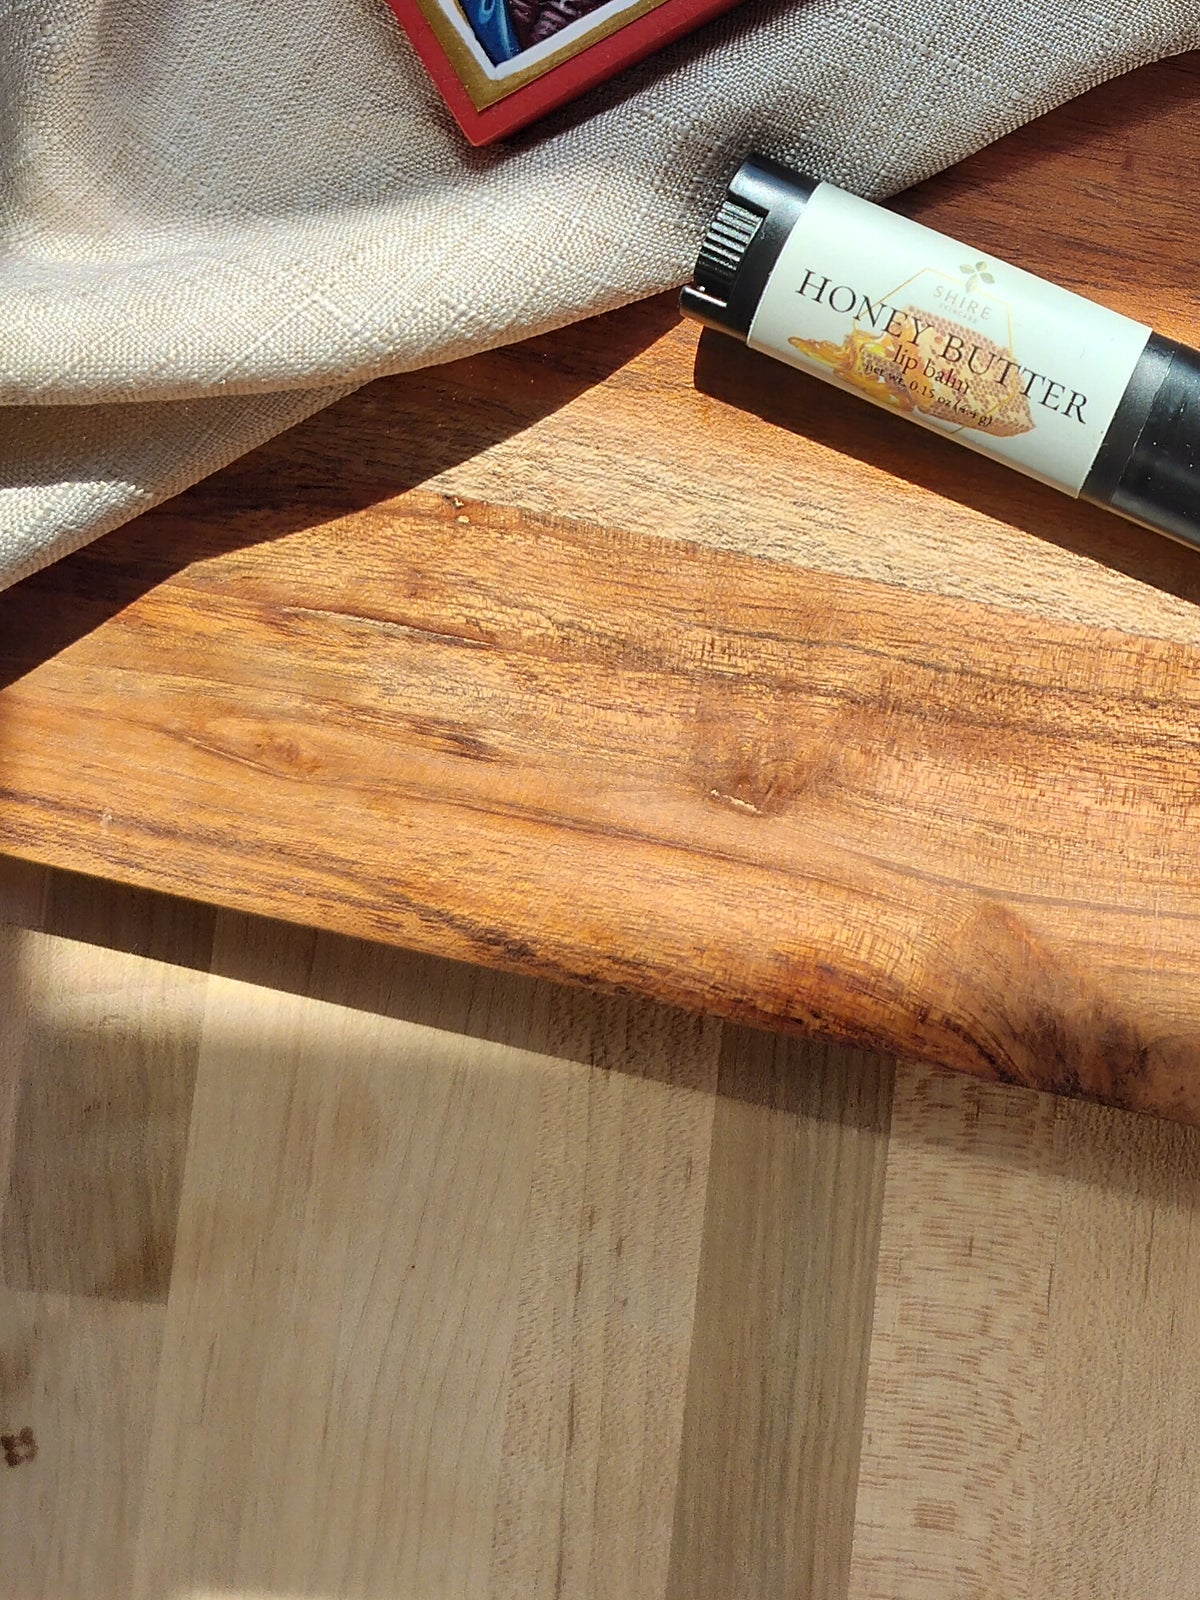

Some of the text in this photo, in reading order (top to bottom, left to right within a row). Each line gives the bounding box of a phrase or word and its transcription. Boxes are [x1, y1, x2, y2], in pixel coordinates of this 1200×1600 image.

[933, 285, 993, 321] SHIRE
[795, 268, 1089, 424] HONEY BUTTER
[892, 344, 970, 396] lip balm
[864, 362, 885, 378] net
[887, 373, 907, 388] wt.
[909, 380, 935, 400] 0.15
[937, 396, 952, 407] oz
[977, 412, 993, 427] g)
